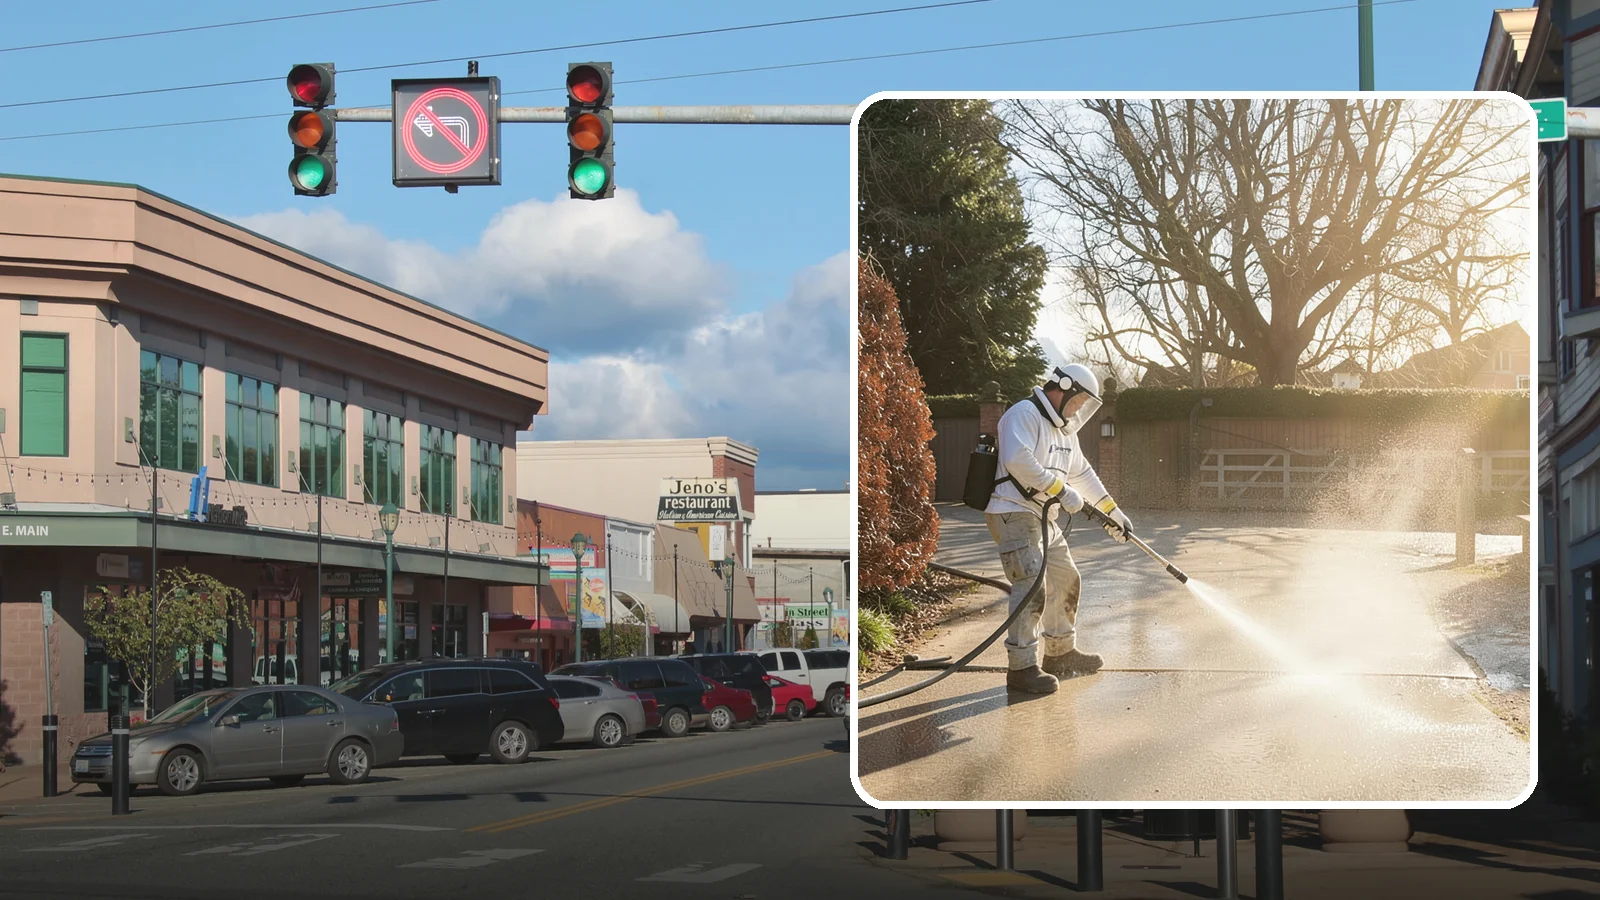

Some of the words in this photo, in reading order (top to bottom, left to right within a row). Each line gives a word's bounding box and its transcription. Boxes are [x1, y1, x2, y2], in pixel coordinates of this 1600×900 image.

[670, 480, 727, 494] Jeno's
[665, 496, 731, 509] restaurant
[658, 509, 682, 520] Italian
[686, 509, 714, 519] American
[715, 509, 737, 519] Cuisine
[2, 525, 13, 536] E.
[15, 525, 49, 536] MAIN
[797, 608, 828, 616] Street
